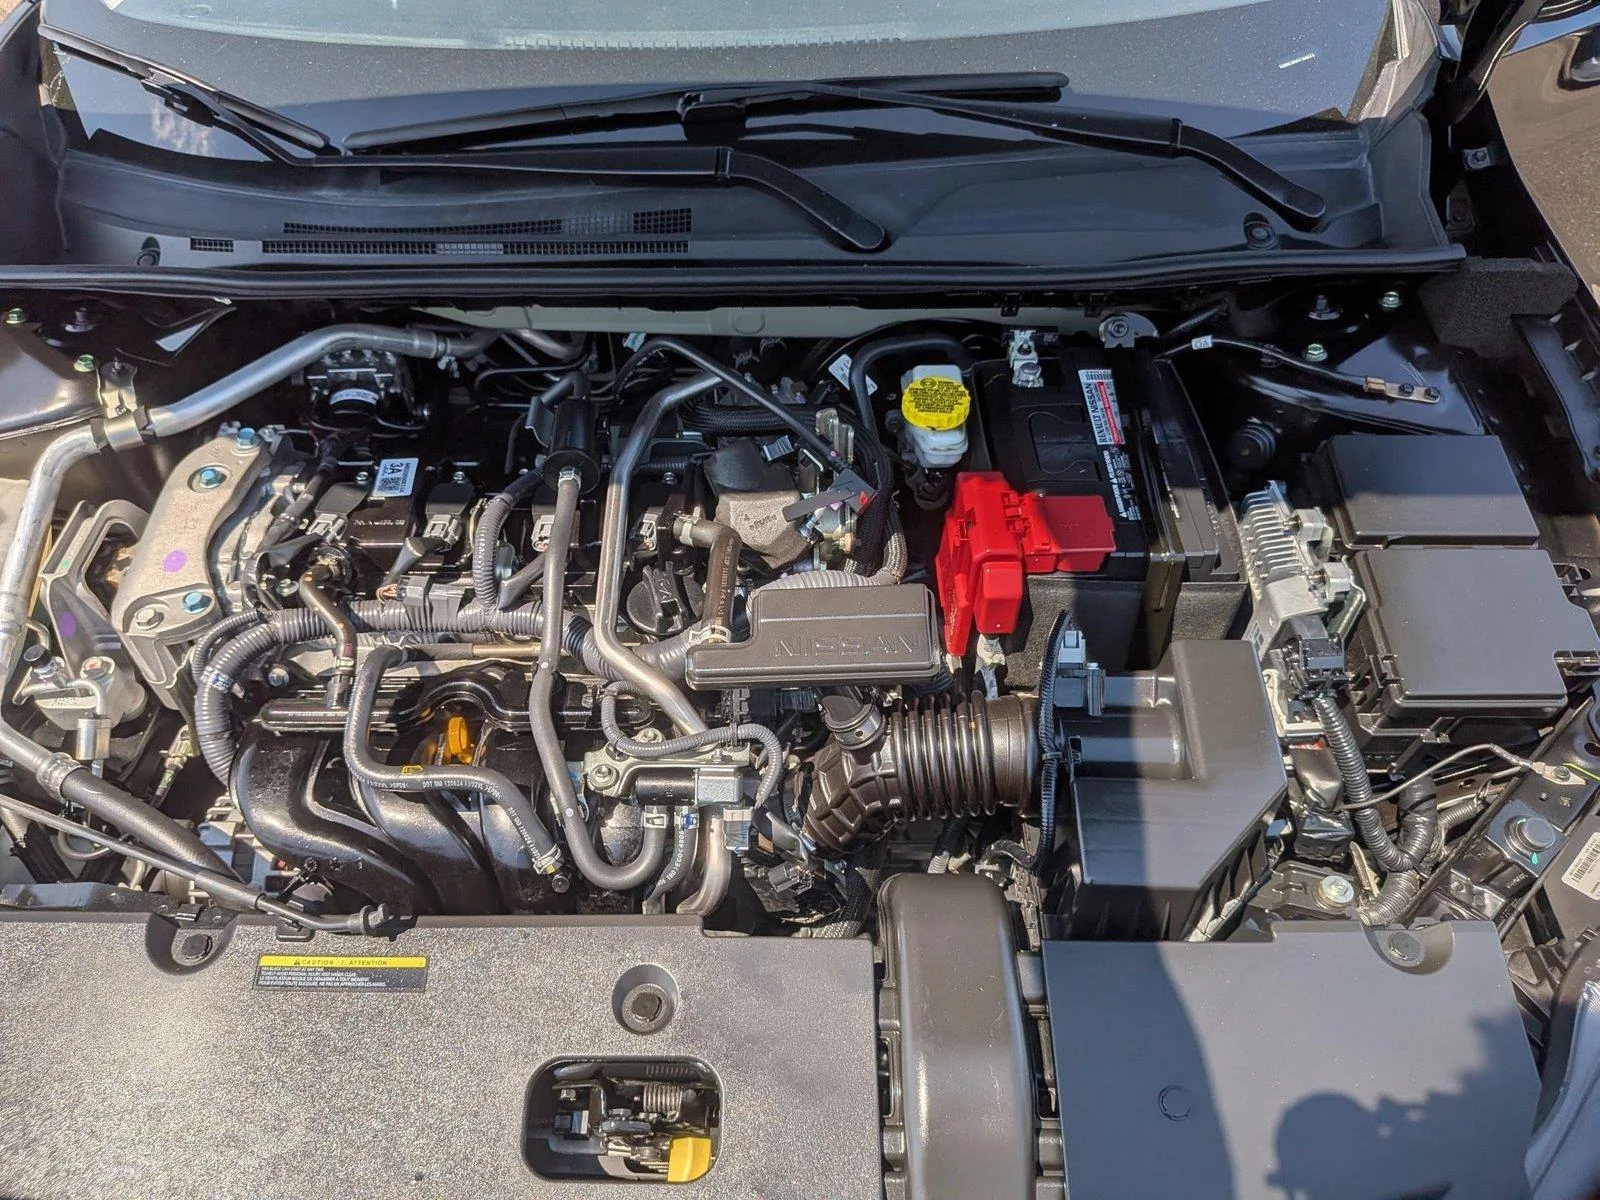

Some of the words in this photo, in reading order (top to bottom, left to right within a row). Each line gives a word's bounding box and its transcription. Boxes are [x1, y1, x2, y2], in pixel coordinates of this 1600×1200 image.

[1084, 381, 1099, 413] NISSAN
[1093, 414, 1108, 443] RENAULT
[773, 633, 918, 657] NISSAN
